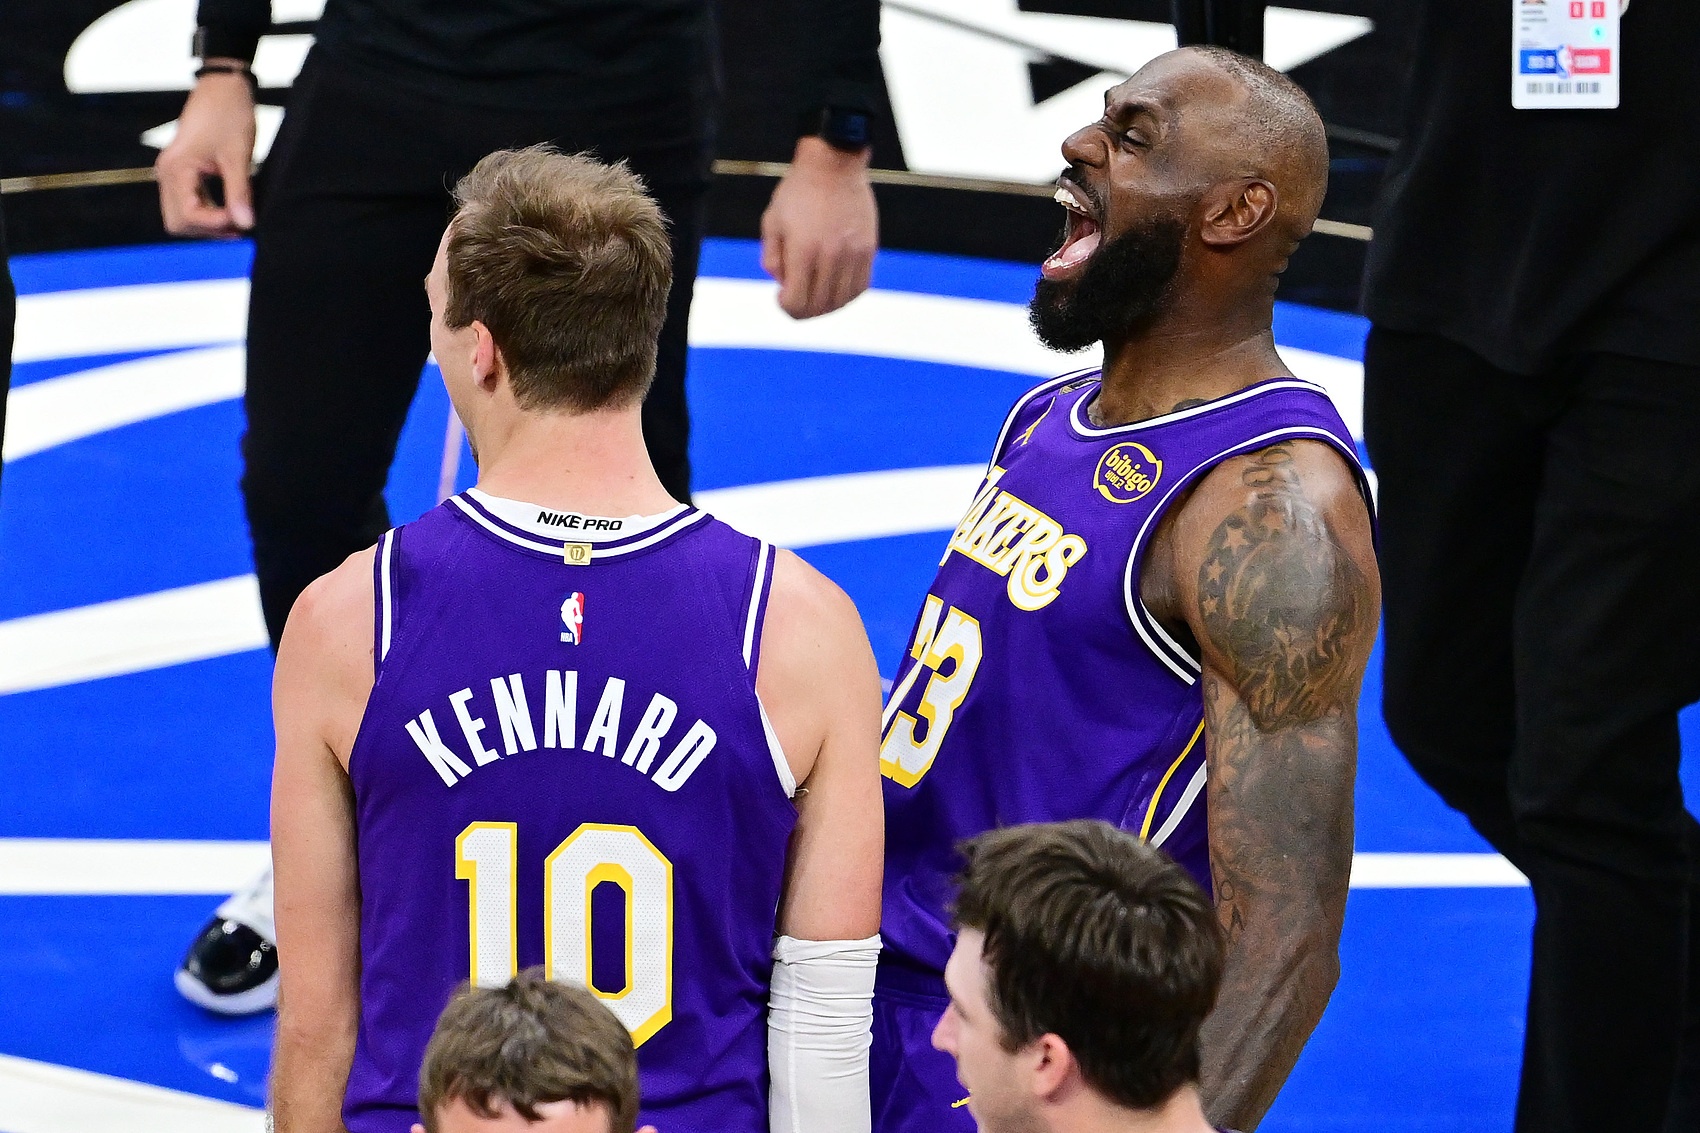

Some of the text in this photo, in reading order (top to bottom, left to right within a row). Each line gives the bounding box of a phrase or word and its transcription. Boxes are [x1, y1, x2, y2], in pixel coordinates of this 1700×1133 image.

[1105, 449, 1151, 492] bibigo
[537, 511, 623, 530] NIKE PRO
[560, 632, 573, 642] NBA
[404, 669, 718, 792] KENNARD
[455, 820, 673, 1050] 10
